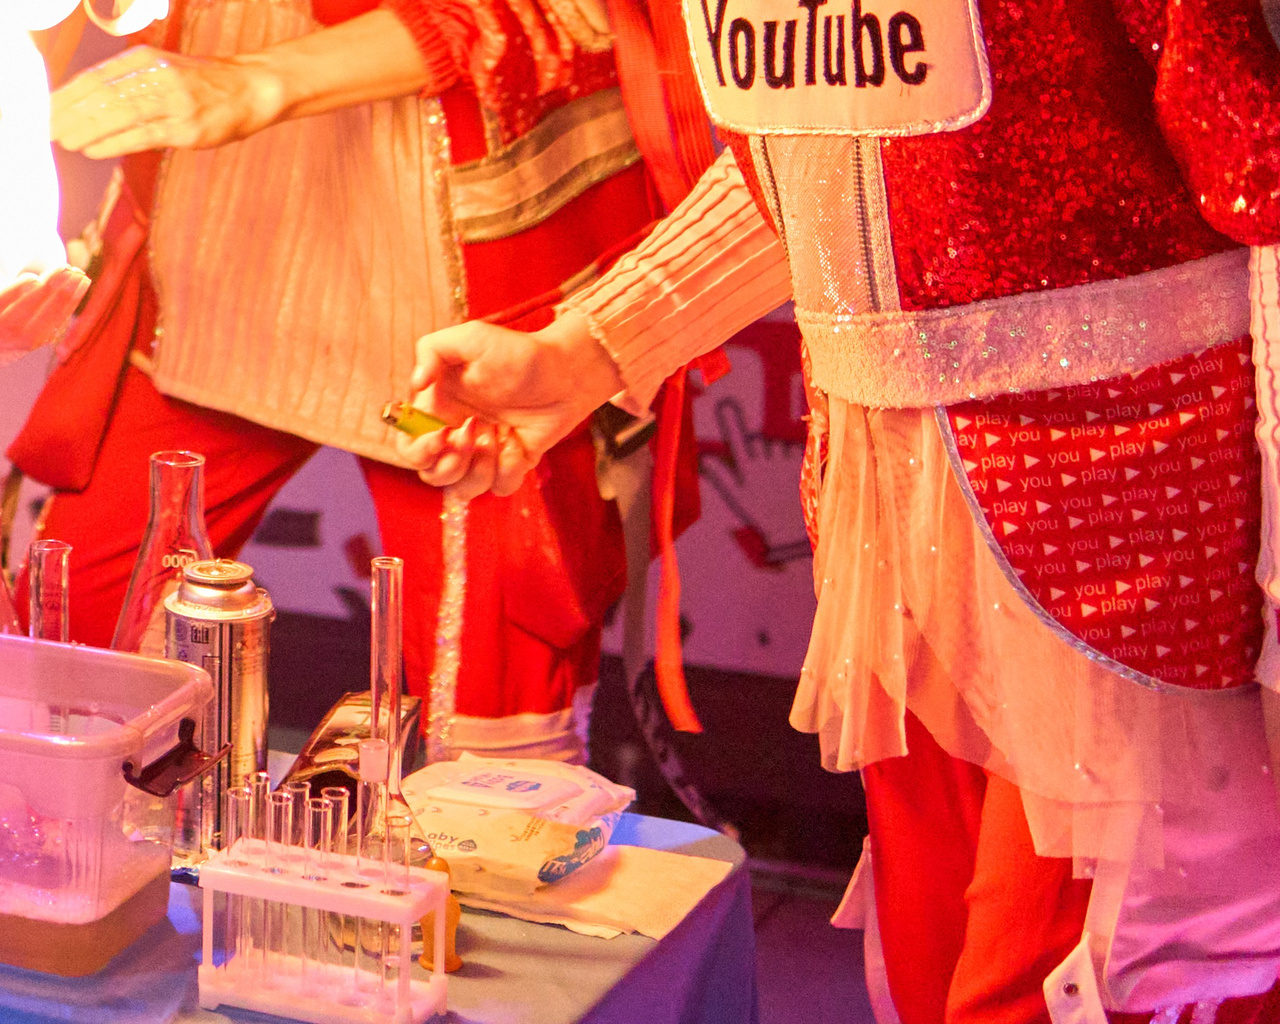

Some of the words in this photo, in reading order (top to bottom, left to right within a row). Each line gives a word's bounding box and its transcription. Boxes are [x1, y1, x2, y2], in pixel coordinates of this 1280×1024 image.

[1189, 358, 1225, 380] play
[975, 410, 1011, 429] play
[1043, 410, 1075, 426] you
[1106, 403, 1141, 420] play
[1172, 390, 1203, 410] you
[1230, 375, 1252, 393] pla
[1008, 430, 1041, 447] you
[1071, 424, 1107, 439] play
[1138, 417, 1170, 435] you
[1199, 400, 1232, 421] play
[981, 453, 1016, 472] play
[1047, 450, 1080, 468] you
[1110, 441, 1146, 460] play
[1177, 433, 1208, 452] you
[1020, 476, 1052, 492] you
[1081, 466, 1117, 485] play
[1149, 460, 1181, 479] you
[1208, 446, 1242, 465] play
[993, 499, 1028, 517] play
[1060, 496, 1092, 513] you
[1122, 486, 1157, 504] play
[1191, 478, 1221, 497] you
[1026, 518, 1058, 535] you
[1088, 508, 1124, 526] play
[1156, 502, 1188, 520] you
[1067, 538, 1099, 555] you
[1129, 528, 1165, 546] play
[1196, 523, 1227, 542] you
[1034, 562, 1066, 576] you
[1096, 553, 1131, 571] play
[1162, 549, 1195, 567] you
[1074, 583, 1106, 601] you
[1135, 573, 1171, 593] play
[1050, 605, 1072, 618] ou
[1101, 596, 1137, 615] play
[1168, 592, 1200, 611] you
[1079, 627, 1111, 641] you
[1112, 642, 1148, 660] play
